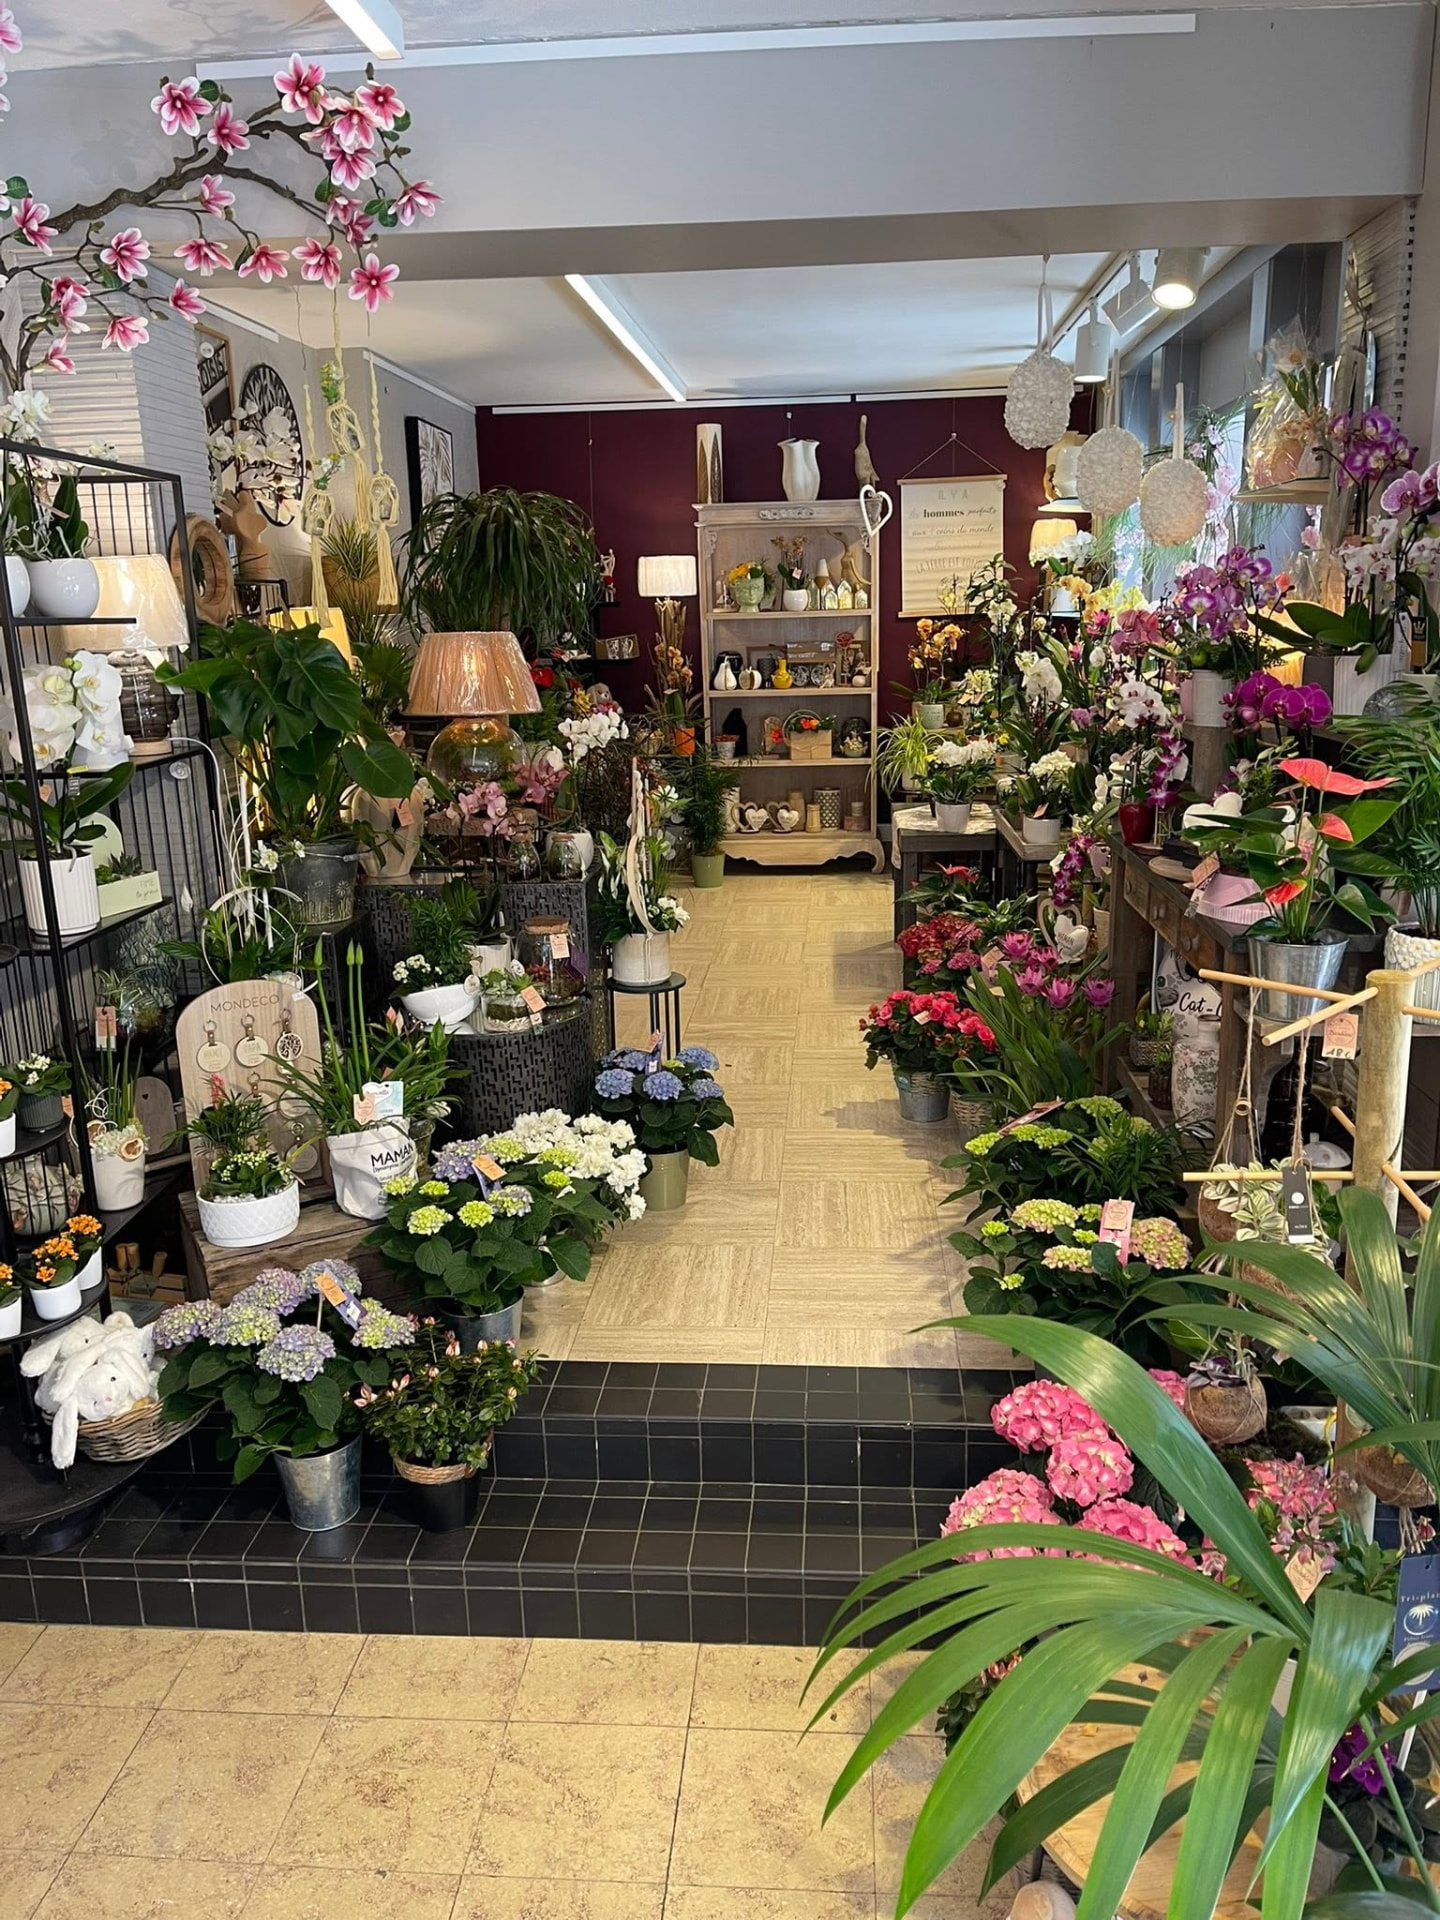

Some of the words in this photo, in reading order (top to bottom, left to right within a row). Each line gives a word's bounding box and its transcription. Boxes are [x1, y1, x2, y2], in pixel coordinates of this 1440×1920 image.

[923, 508, 965, 519] hommes
[210, 994, 280, 1014] MONDECO
[370, 1143, 414, 1168] MAMAN
